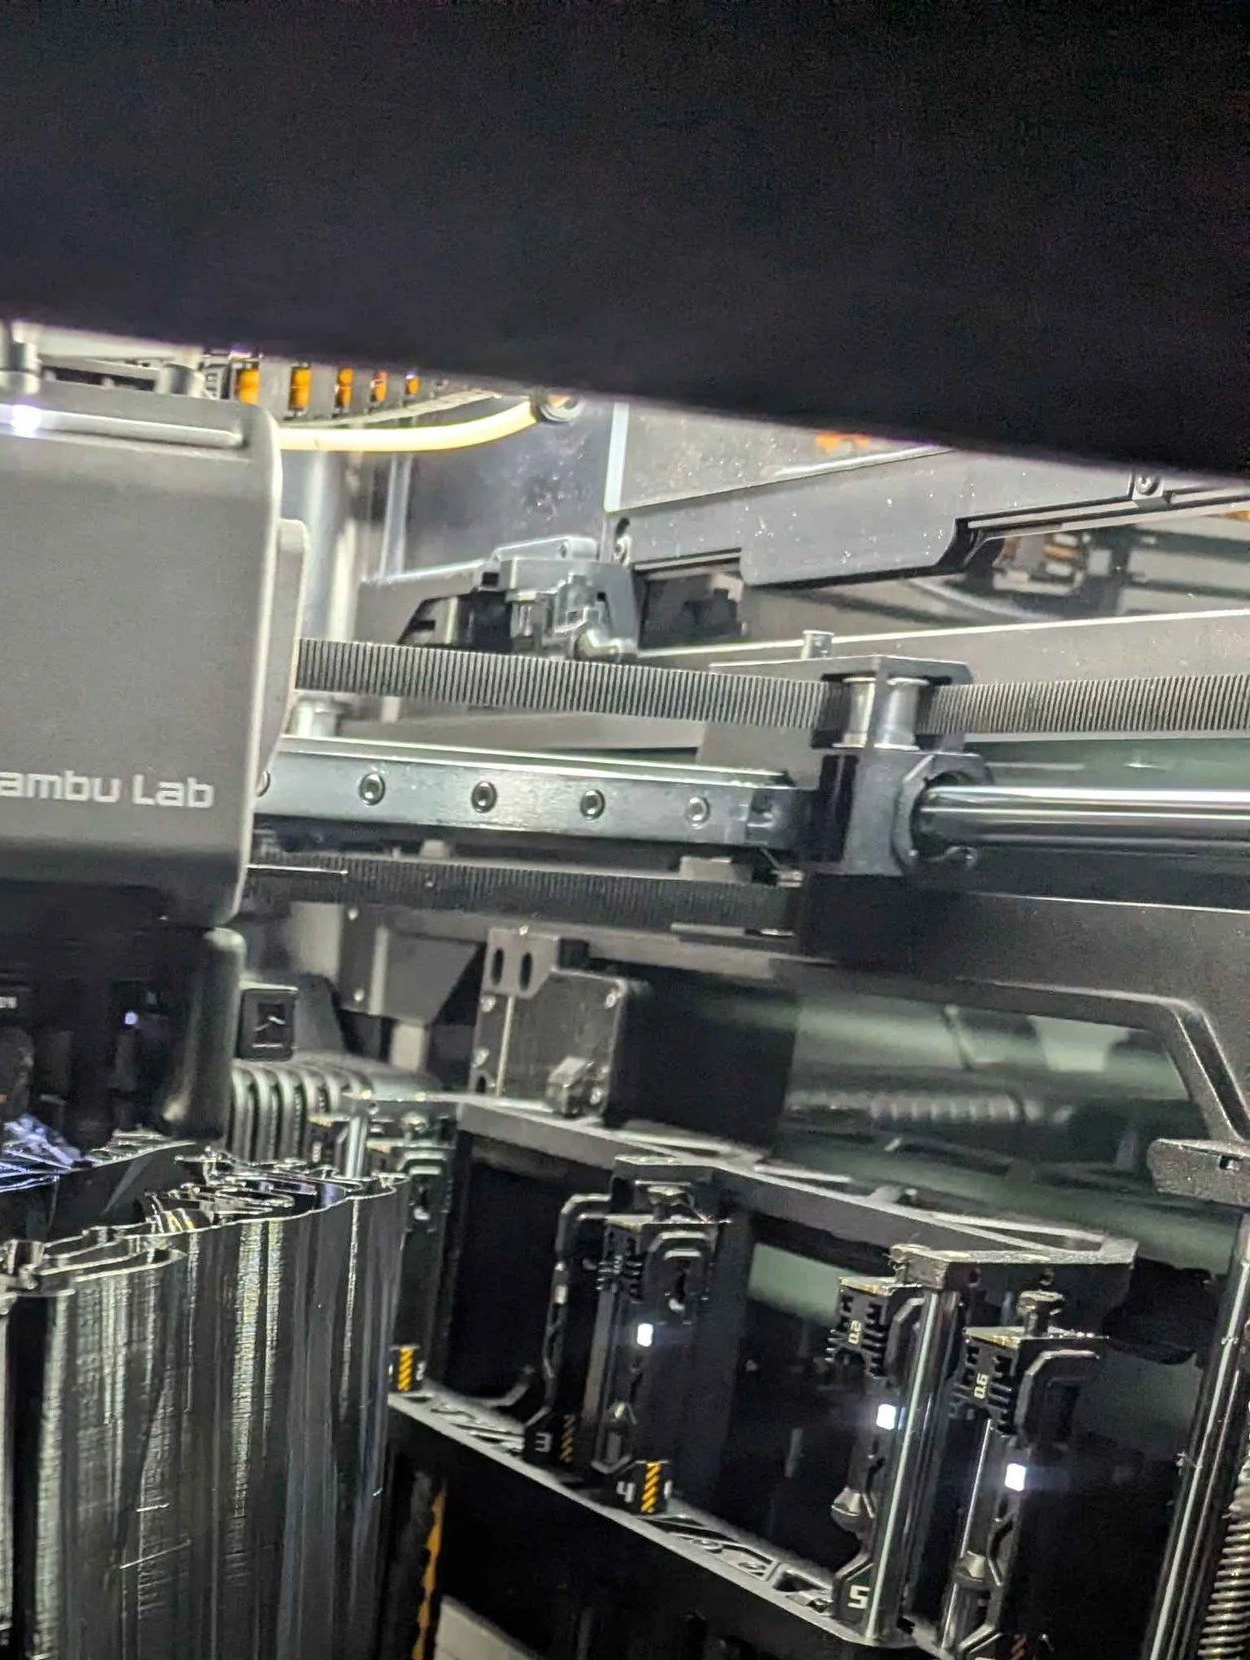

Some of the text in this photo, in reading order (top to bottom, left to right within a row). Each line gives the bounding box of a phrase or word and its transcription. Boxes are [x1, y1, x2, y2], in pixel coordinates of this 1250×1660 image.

[132, 774, 215, 809] Lab
[973, 1372, 988, 1400] 0.6
[534, 1432, 551, 1453] 3
[615, 1480, 636, 1503] 4
[847, 1584, 871, 1610] 5
